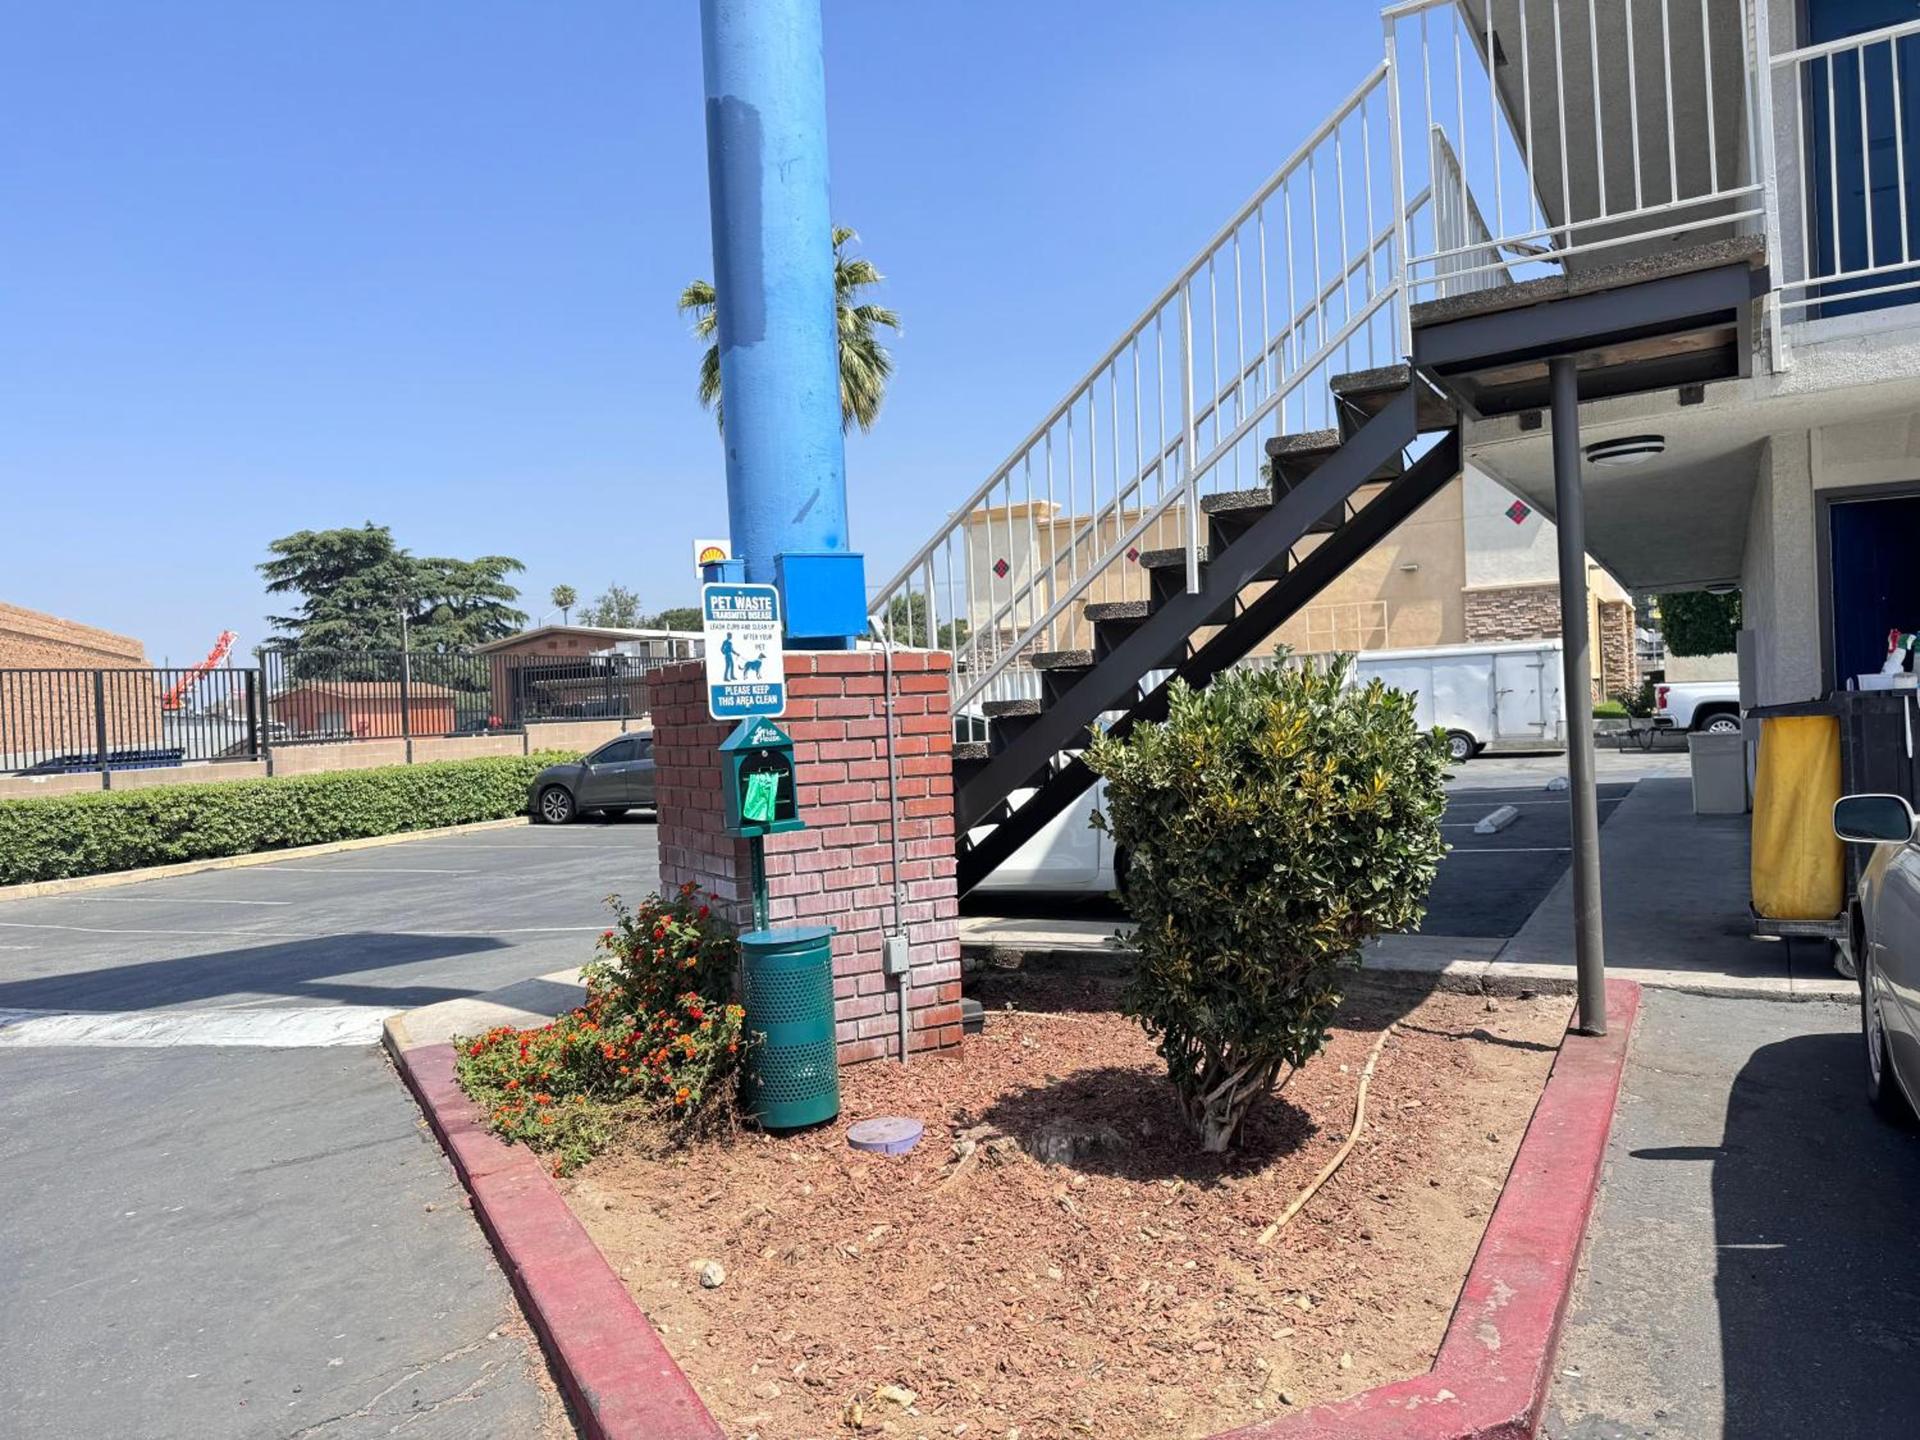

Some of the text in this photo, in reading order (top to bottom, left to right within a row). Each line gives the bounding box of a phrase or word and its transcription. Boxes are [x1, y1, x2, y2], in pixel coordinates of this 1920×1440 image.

[710, 596, 772, 610] PET WASTE
[748, 611, 773, 620] DISEASE
[725, 684, 770, 696] PLEASE KEEP
[717, 694, 778, 706] THIS AREA CLEAN
